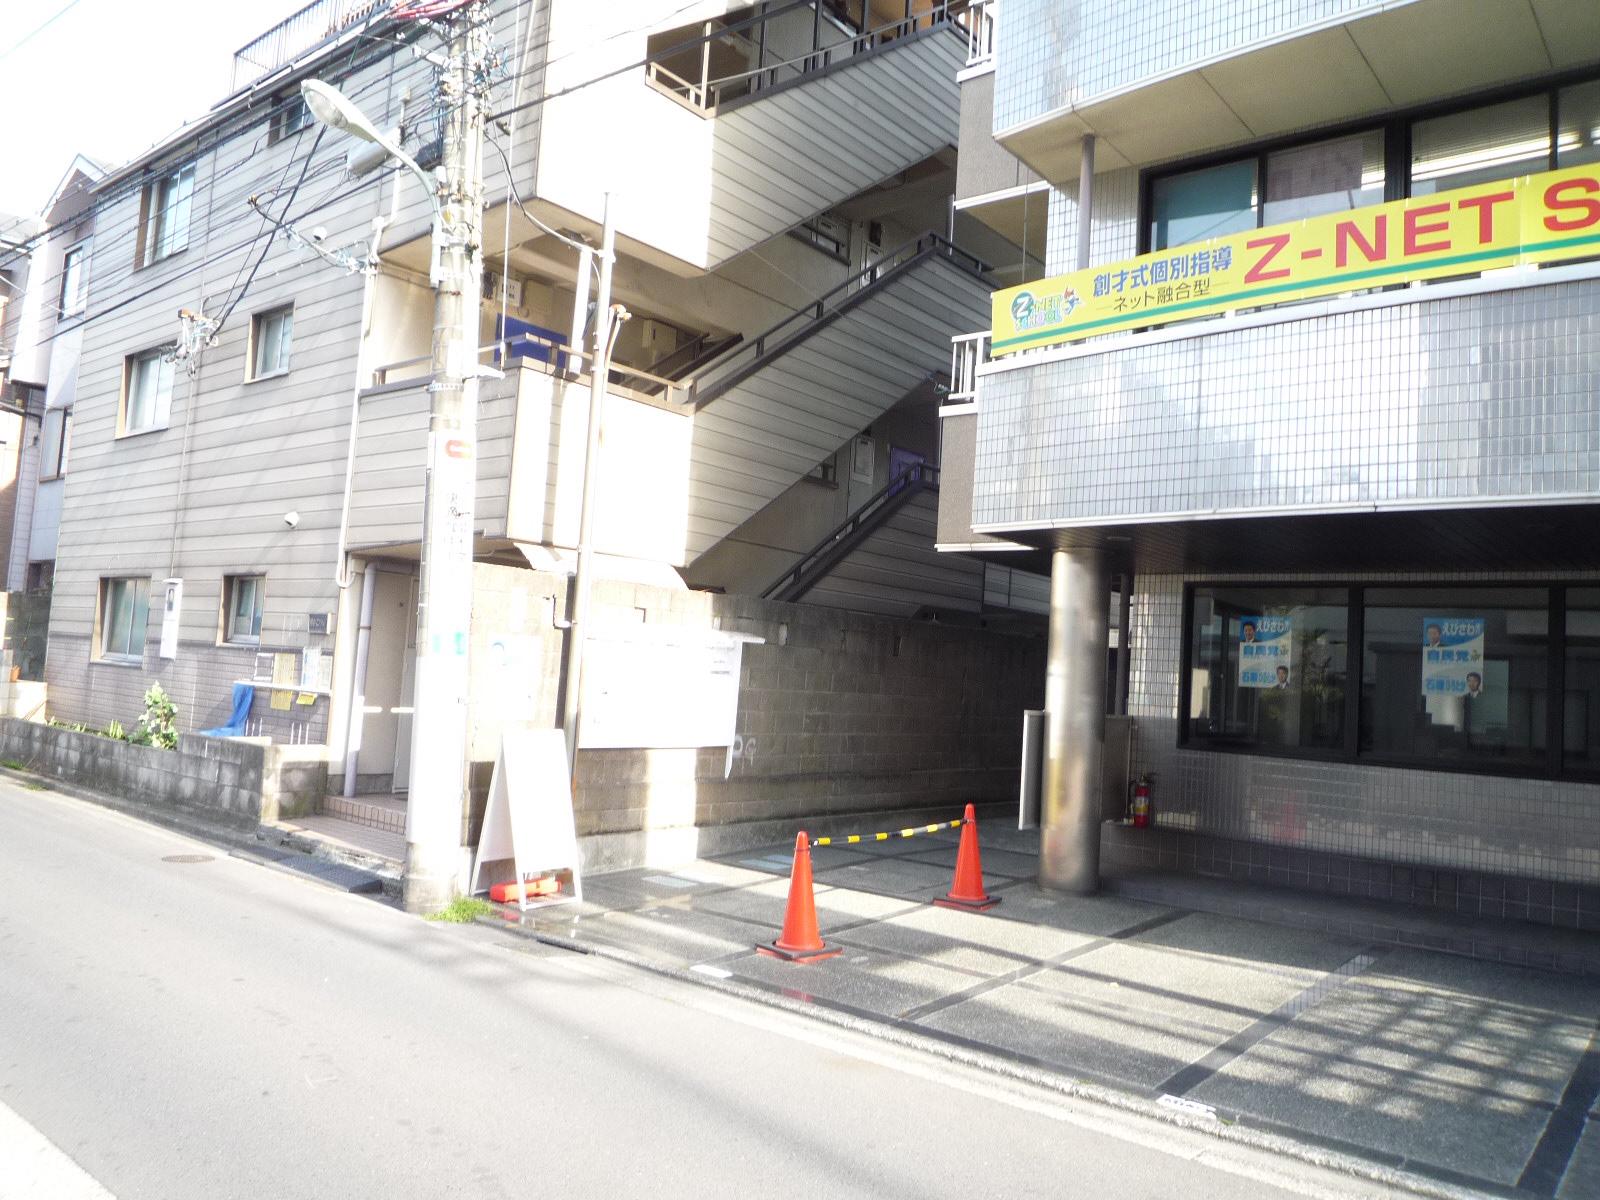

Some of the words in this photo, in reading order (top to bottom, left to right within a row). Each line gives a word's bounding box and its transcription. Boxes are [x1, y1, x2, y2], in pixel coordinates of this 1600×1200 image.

[1243, 191, 1515, 284] Z-NET
[1093, 246, 1232, 297] 創才式個別指導
[1113, 277, 1210, 312] ネット融合型
